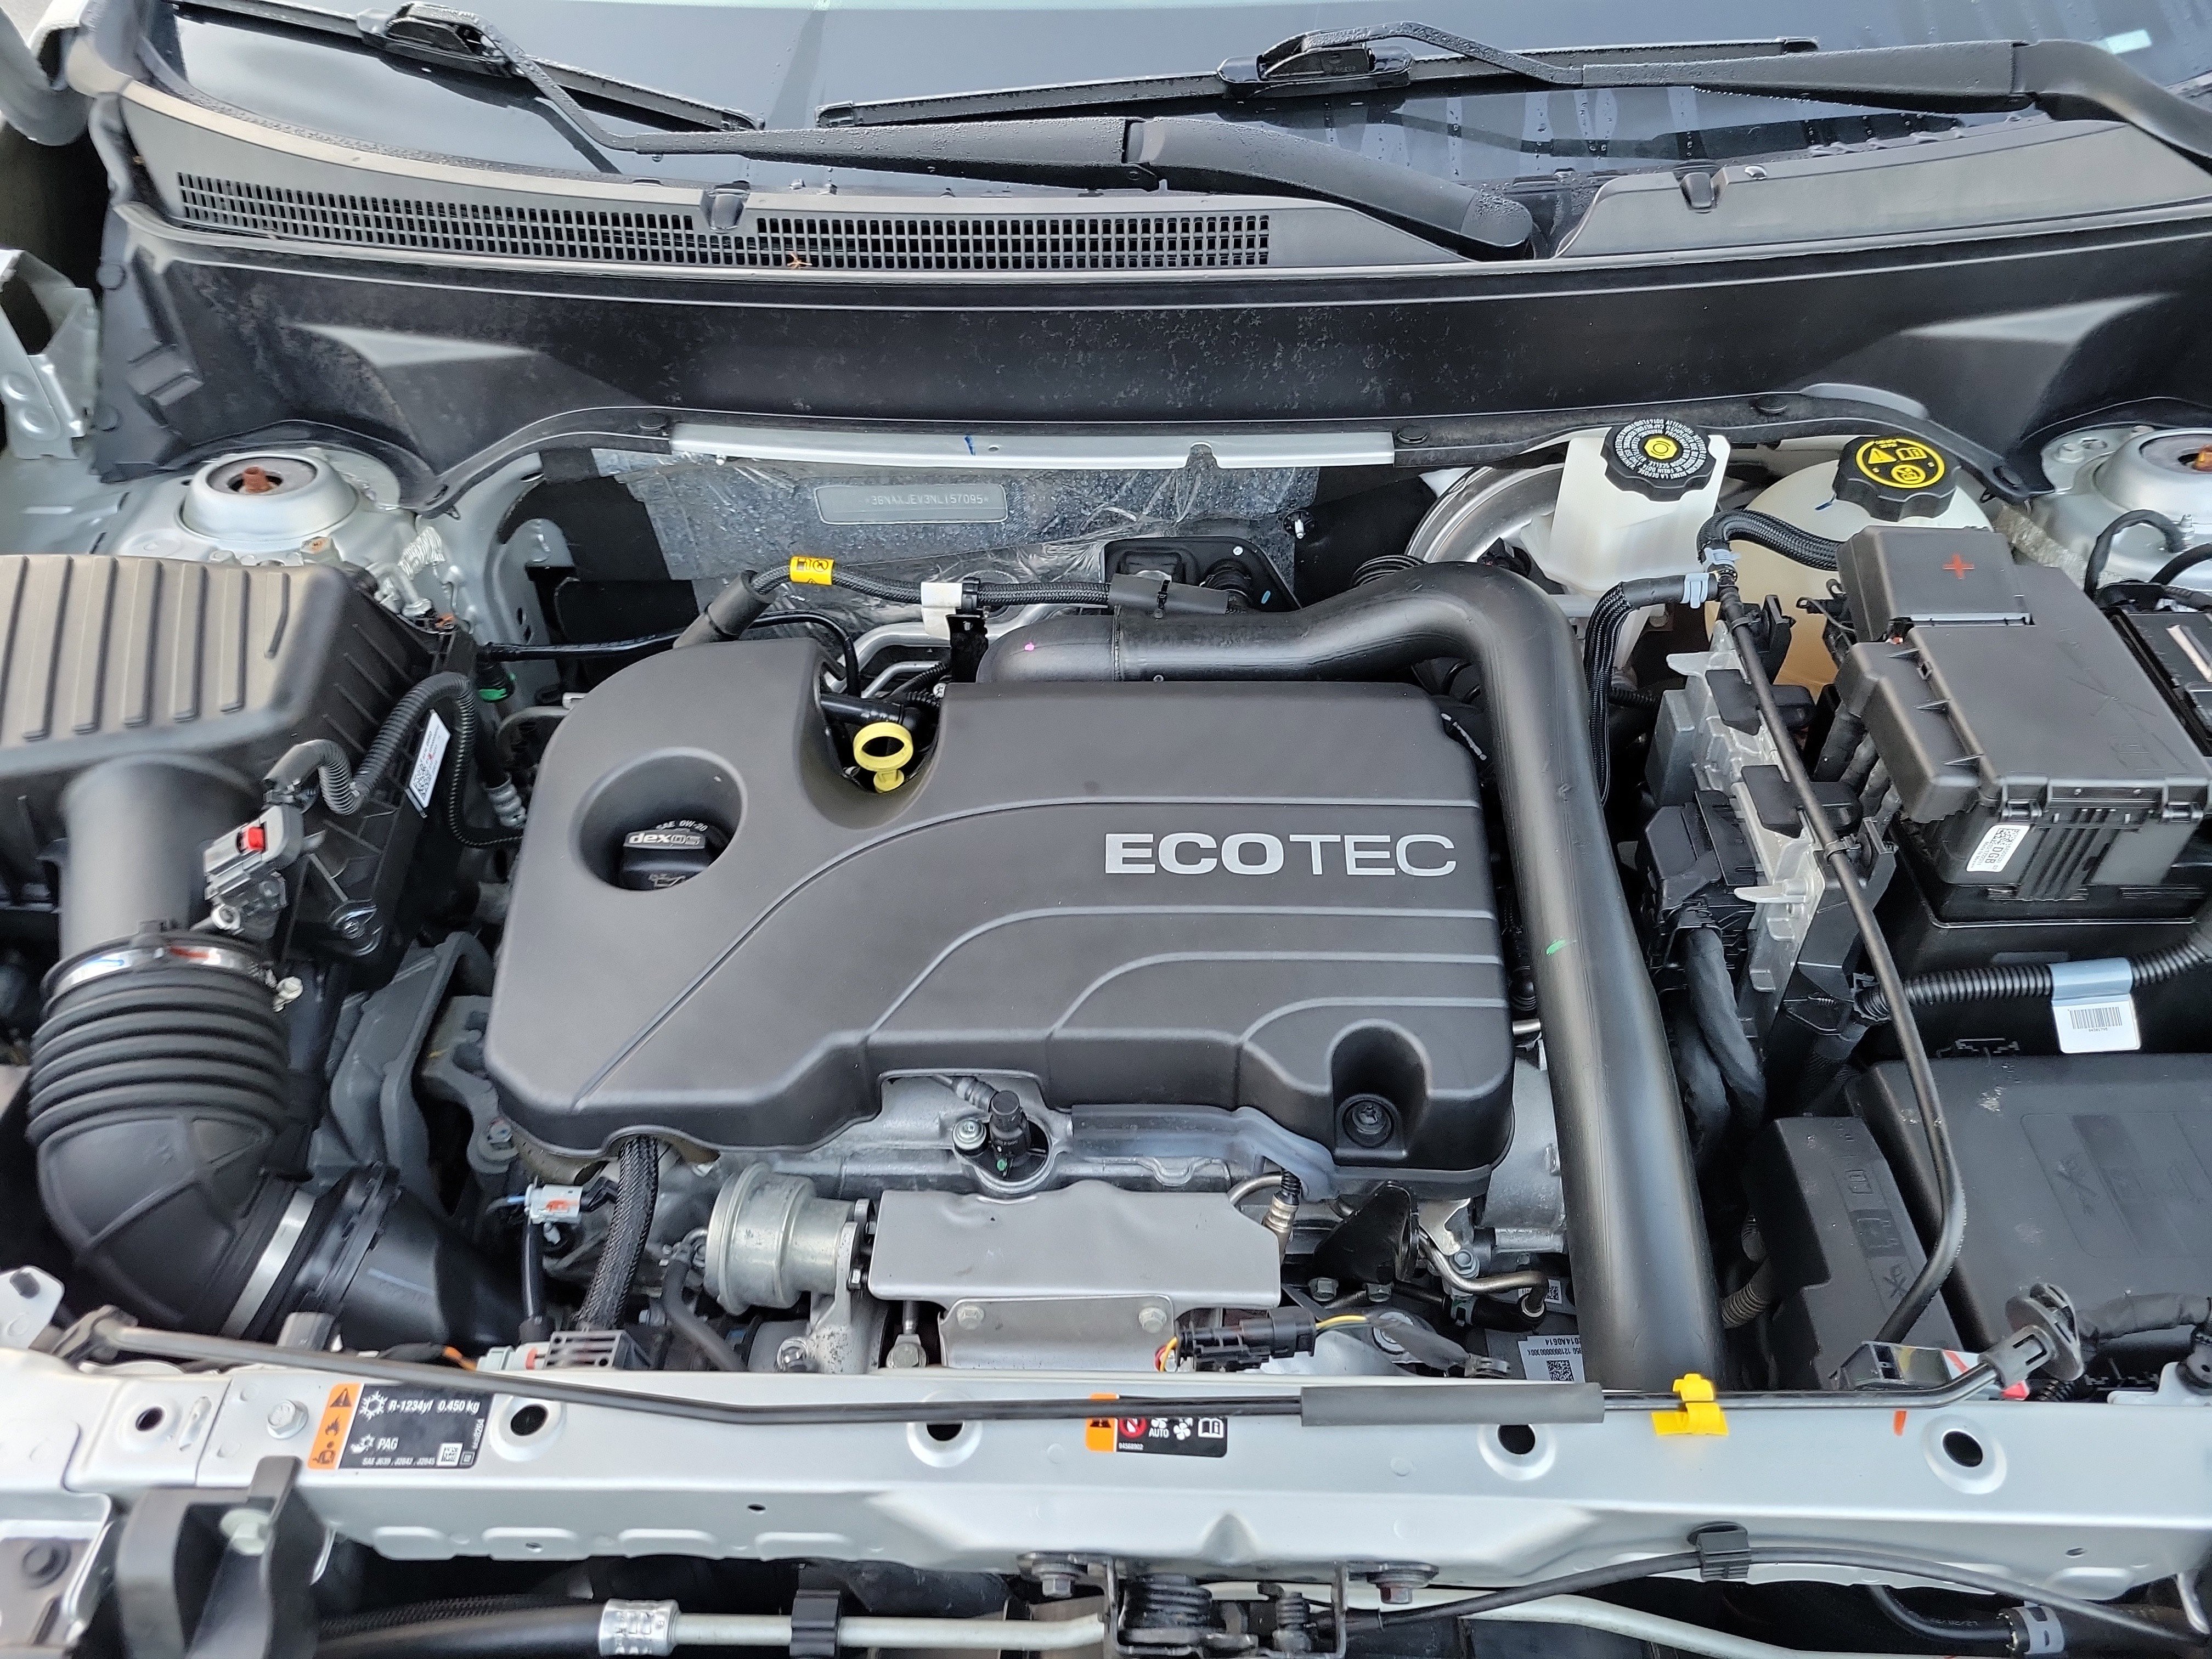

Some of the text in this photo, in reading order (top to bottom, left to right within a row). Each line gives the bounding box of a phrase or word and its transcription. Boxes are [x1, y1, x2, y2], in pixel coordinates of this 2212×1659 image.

[1105, 832, 1457, 877] ECOTEC
[1984, 847, 2004, 864] DGB
[1545, 1338, 1581, 1346] 014A0614
[387, 1400, 481, 1416] R-1234yf 0.450 kg
[1148, 1427, 1170, 1438] AUTO
[376, 1437, 399, 1451] PAG
